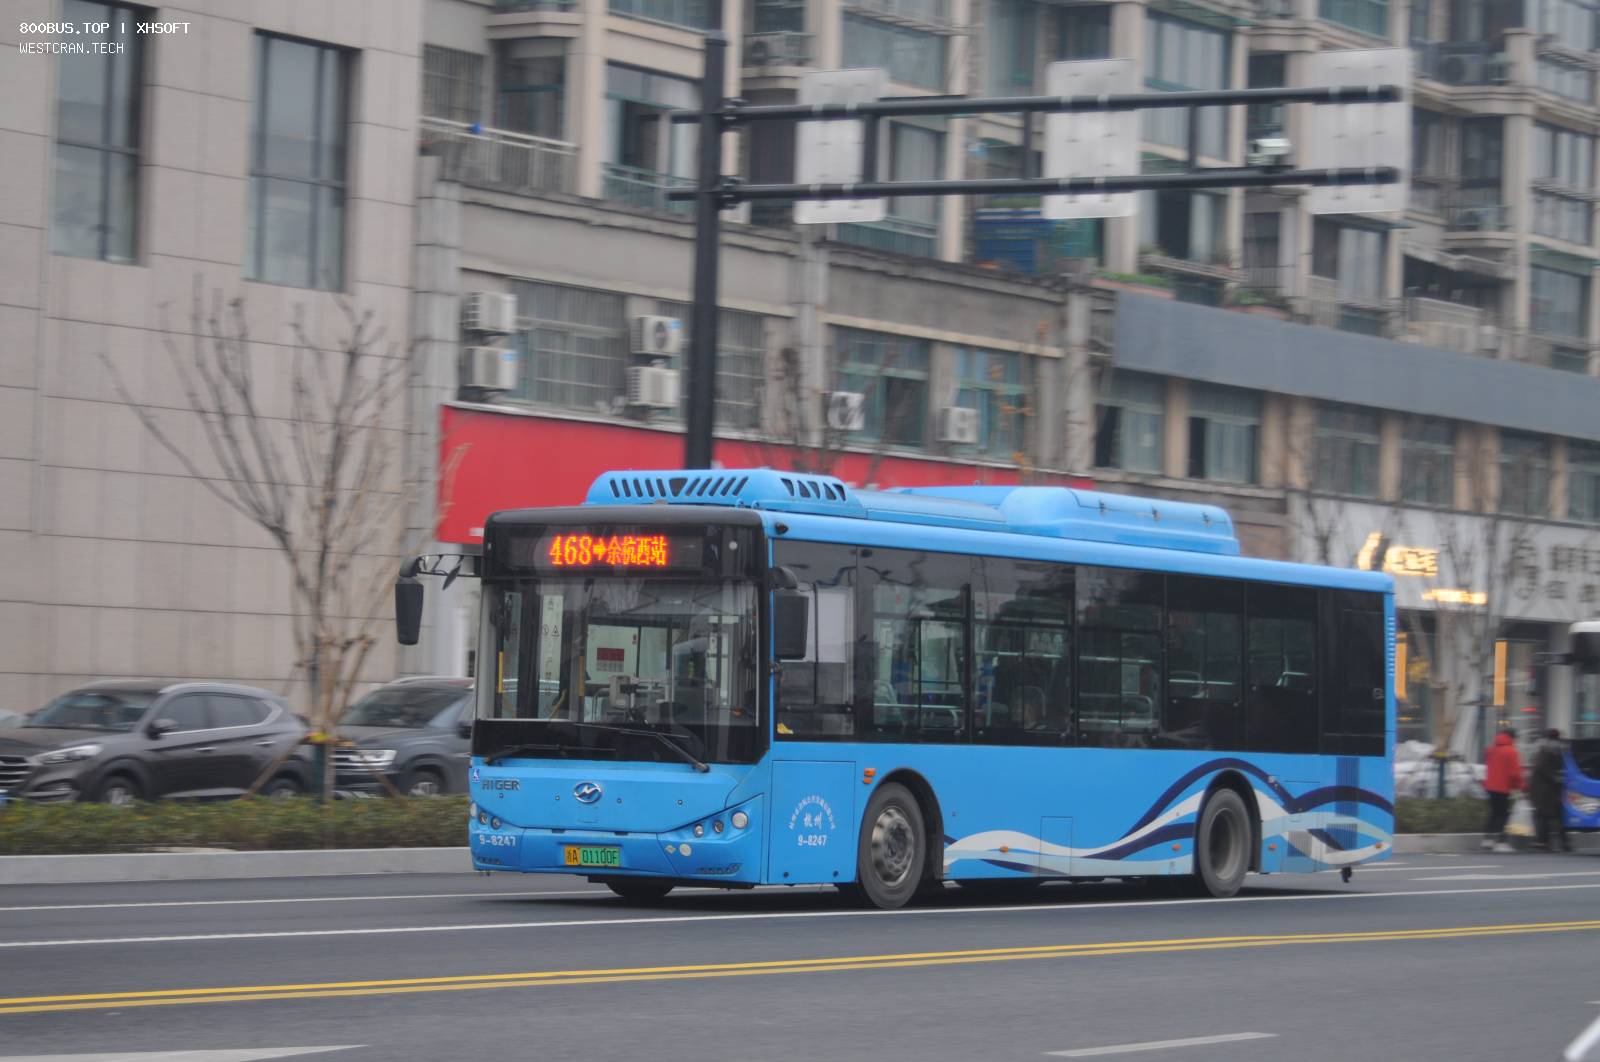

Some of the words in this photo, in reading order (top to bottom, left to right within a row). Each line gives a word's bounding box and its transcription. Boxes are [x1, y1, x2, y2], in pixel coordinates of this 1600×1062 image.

[549, 536, 592, 565] 468
[606, 536, 667, 565] 余杭西站
[482, 779, 520, 791] HIGER
[479, 835, 516, 847] 9-8247
[798, 834, 827, 846] 9-8247
